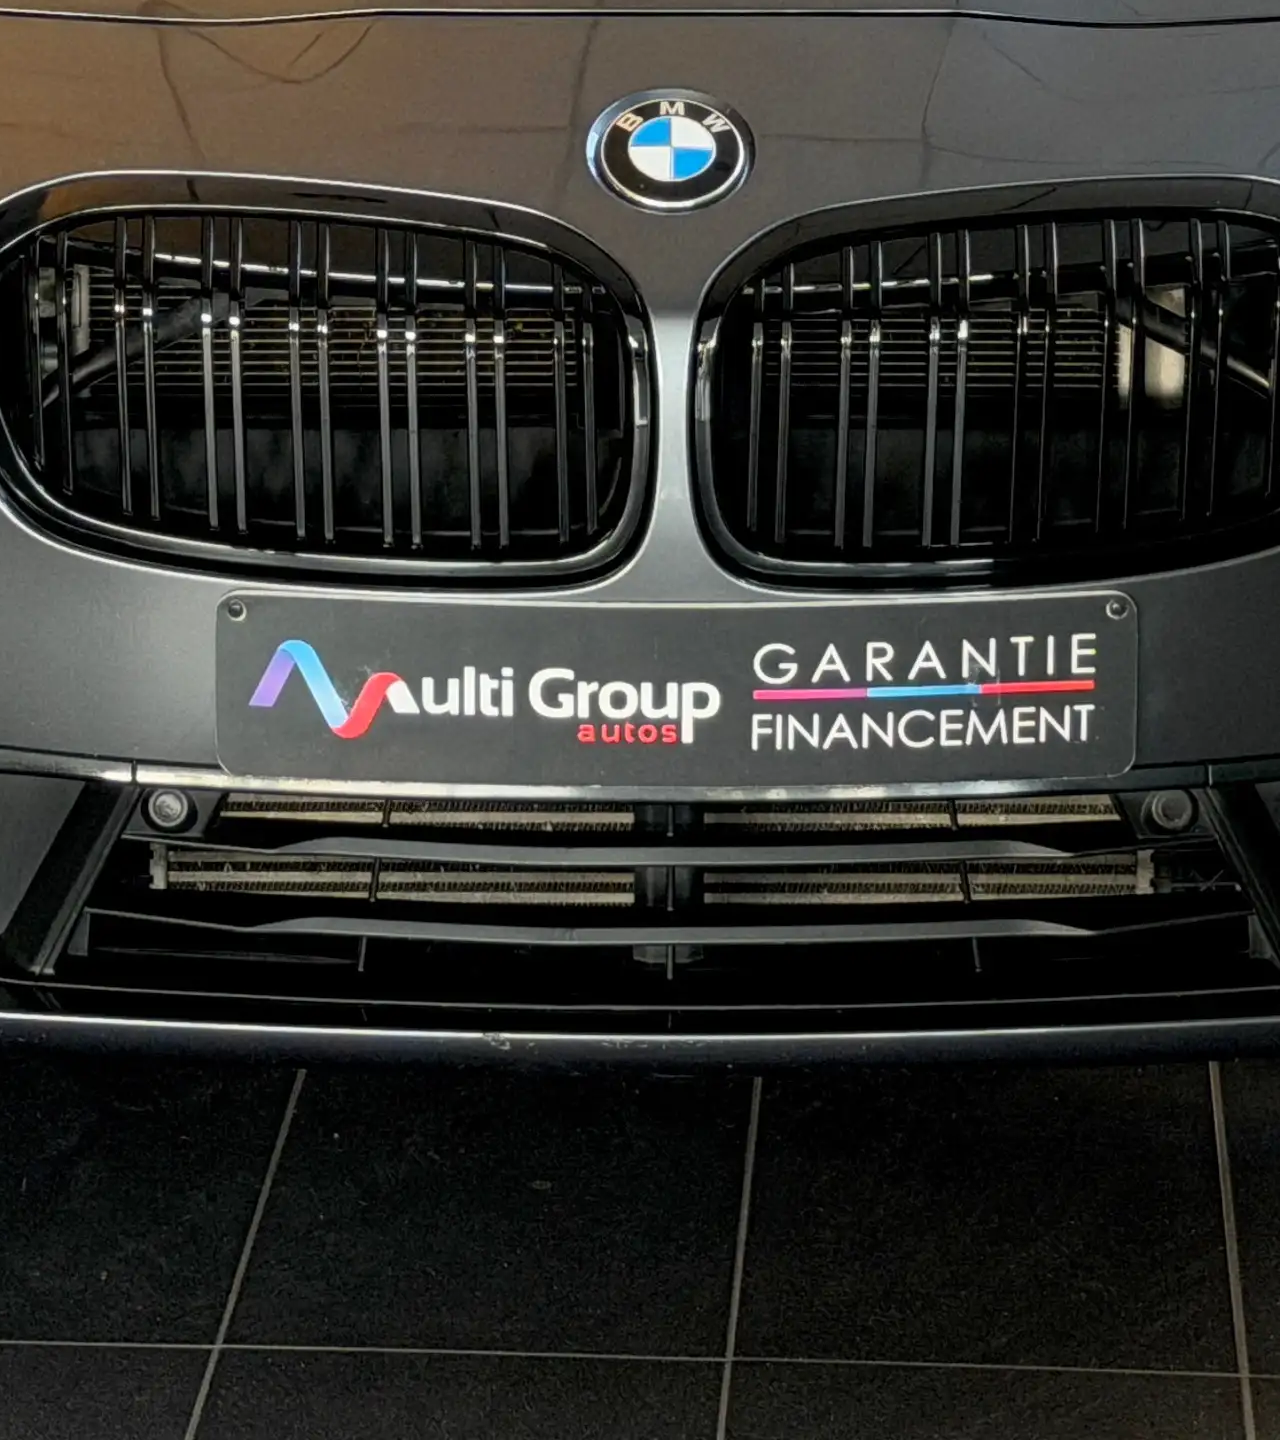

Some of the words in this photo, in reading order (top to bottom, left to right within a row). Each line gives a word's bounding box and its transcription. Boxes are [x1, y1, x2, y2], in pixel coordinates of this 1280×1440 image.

[616, 101, 731, 133] BMW
[753, 633, 1097, 686] GARANTIE
[528, 667, 722, 745] Group
[750, 704, 1096, 752] FINANCEMENT
[576, 723, 678, 744] autos
